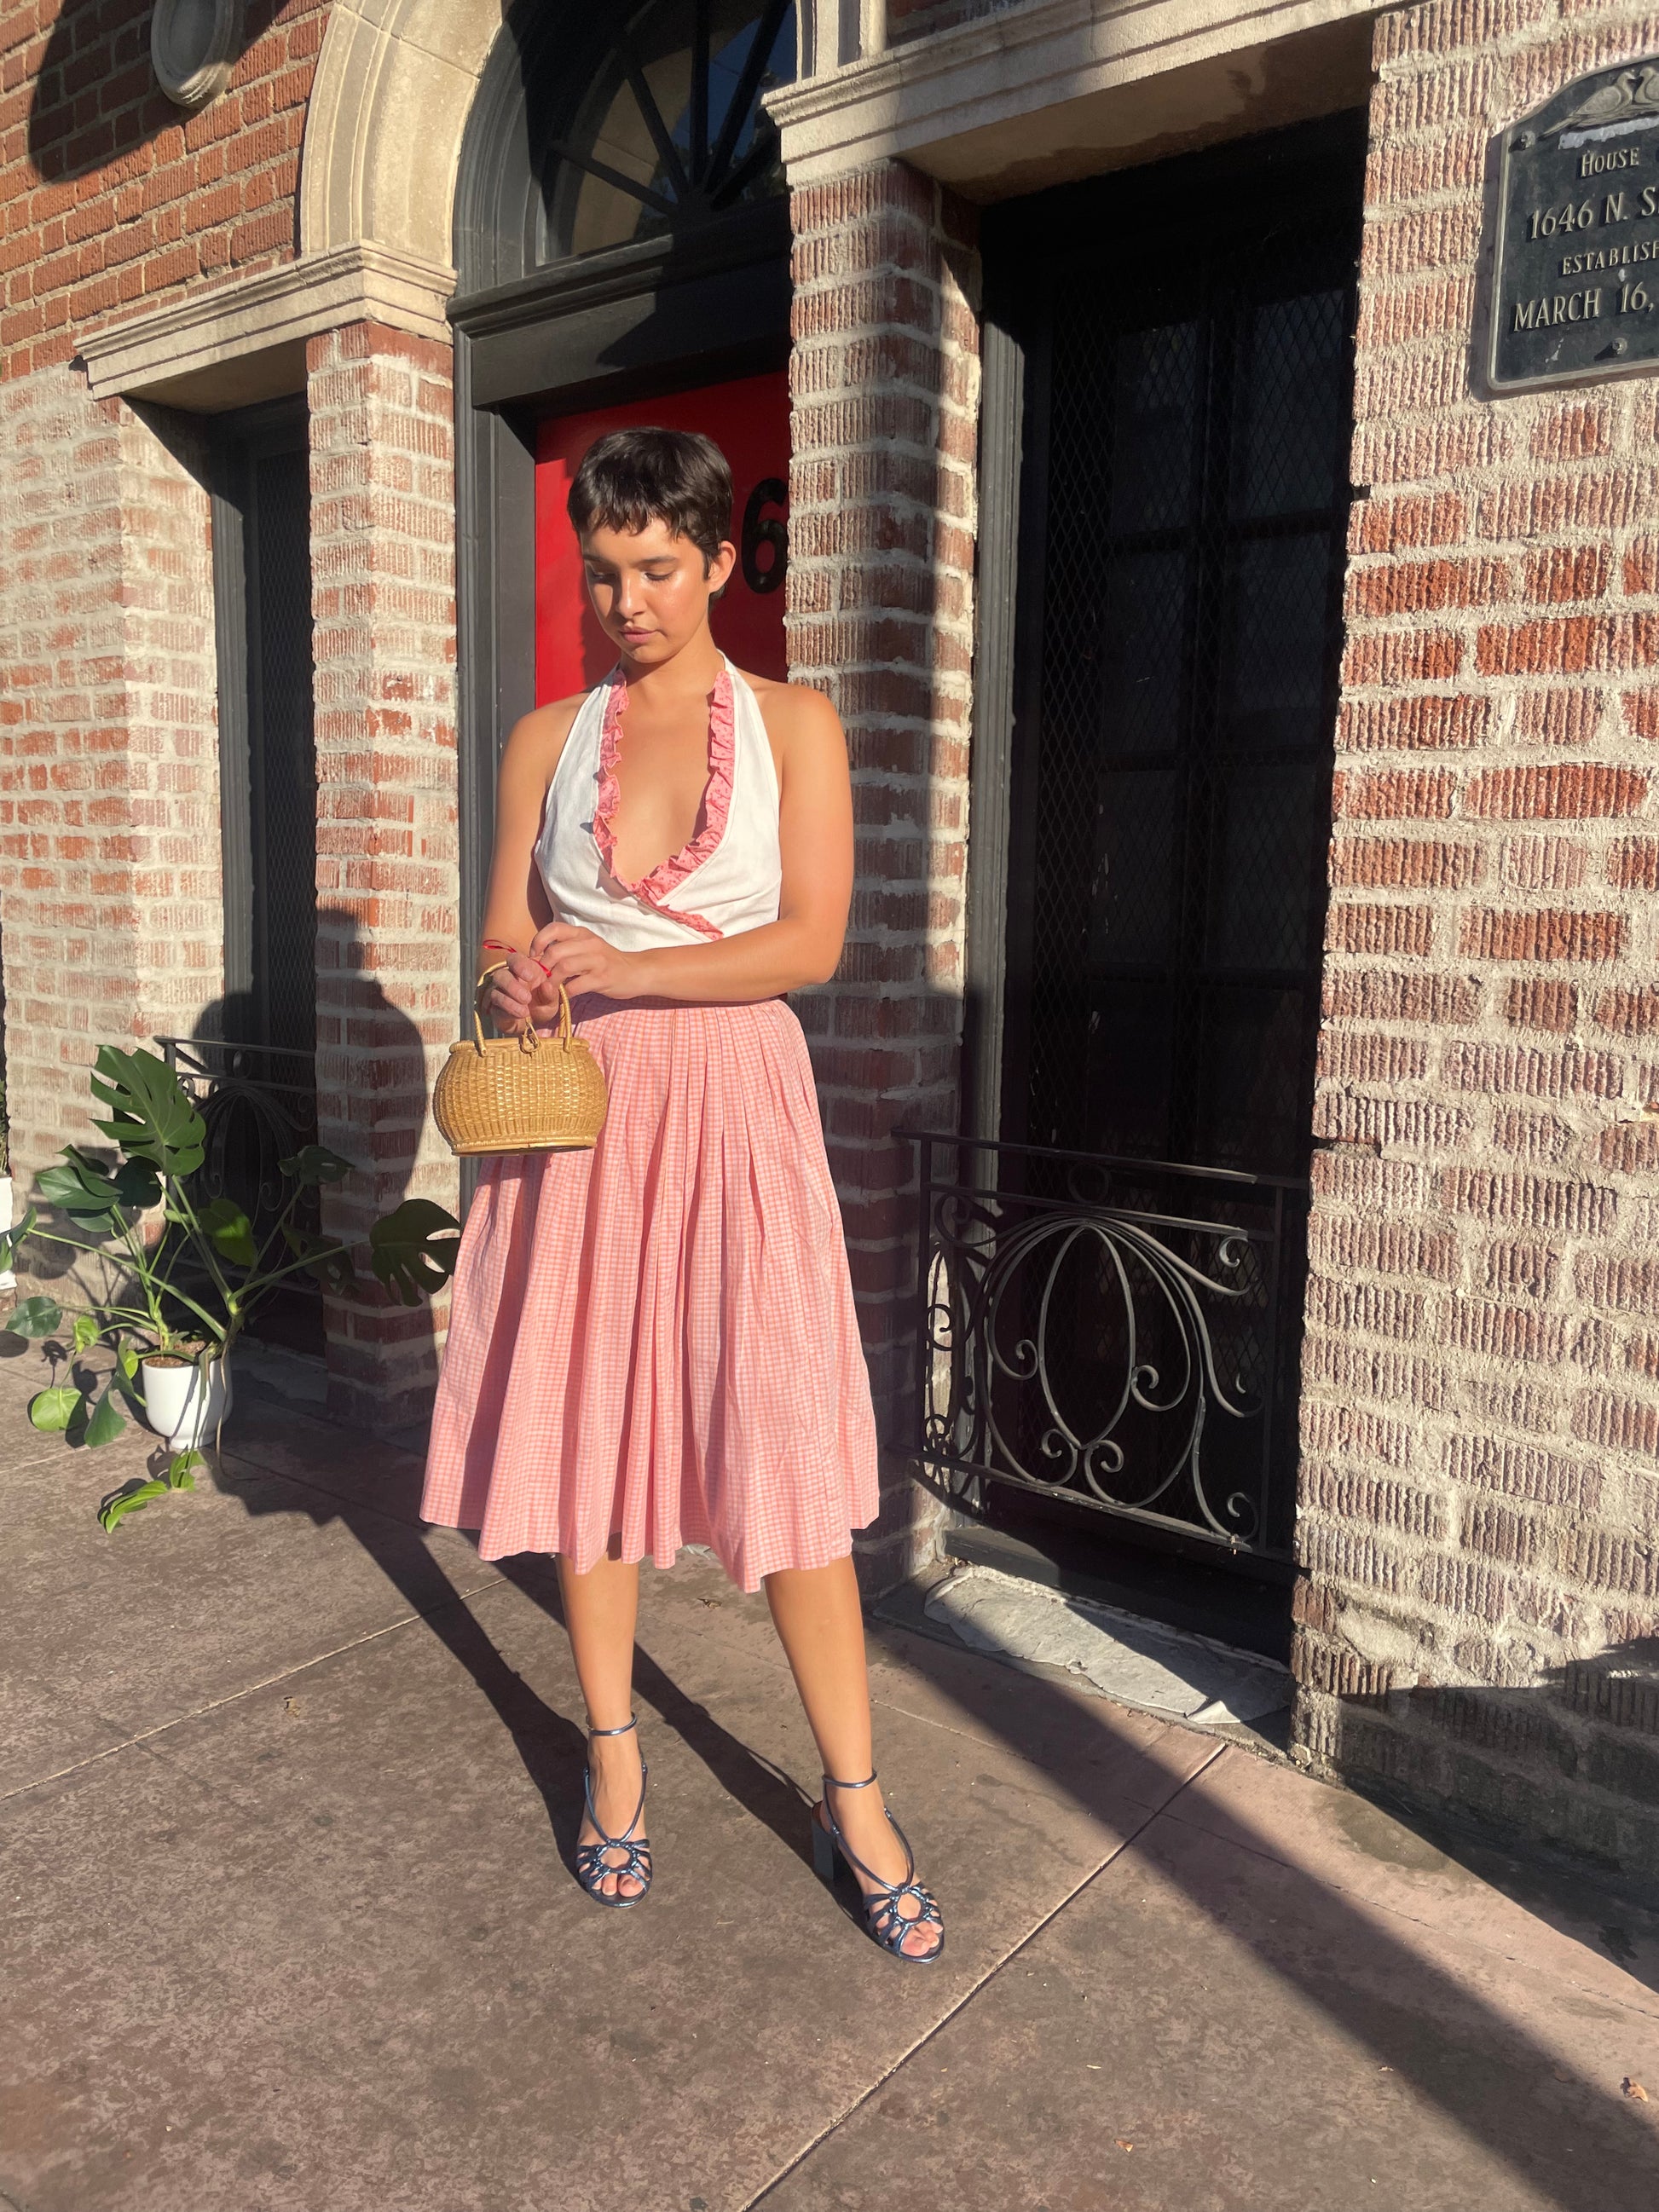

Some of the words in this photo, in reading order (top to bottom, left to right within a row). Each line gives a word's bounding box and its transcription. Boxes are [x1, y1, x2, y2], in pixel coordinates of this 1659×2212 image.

[1580, 147, 1640, 178] HOUSE
[1530, 199, 1593, 240] 1646
[1604, 191, 1628, 224] N.
[1641, 186, 1659, 217] S
[1513, 287, 1602, 332] MARCH
[1621, 280, 1655, 313] 16,
[740, 477, 789, 595] 6
